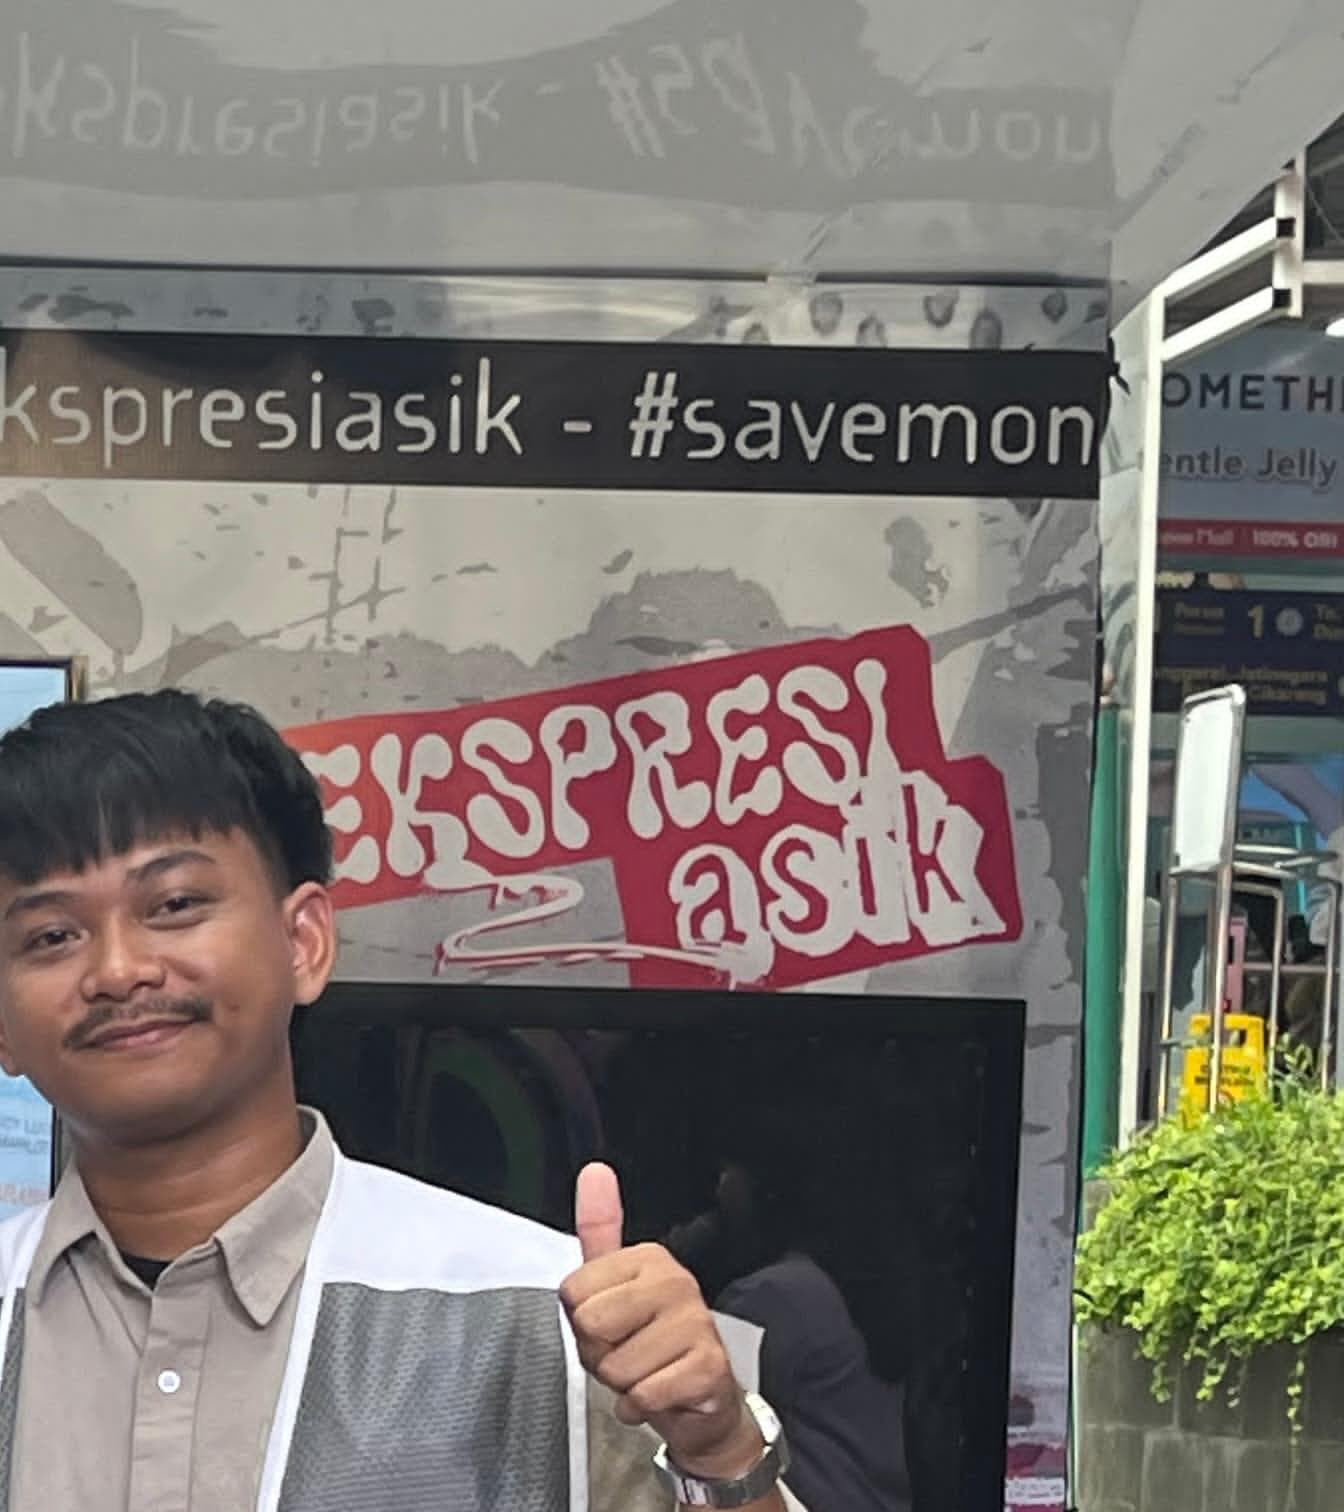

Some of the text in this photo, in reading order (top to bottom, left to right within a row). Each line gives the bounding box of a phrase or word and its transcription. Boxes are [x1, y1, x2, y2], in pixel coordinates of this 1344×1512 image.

[628, 372, 1095, 465] #savemon
[1160, 445, 1337, 488] entle Jelly
[302, 657, 906, 884] EKSPRESI
